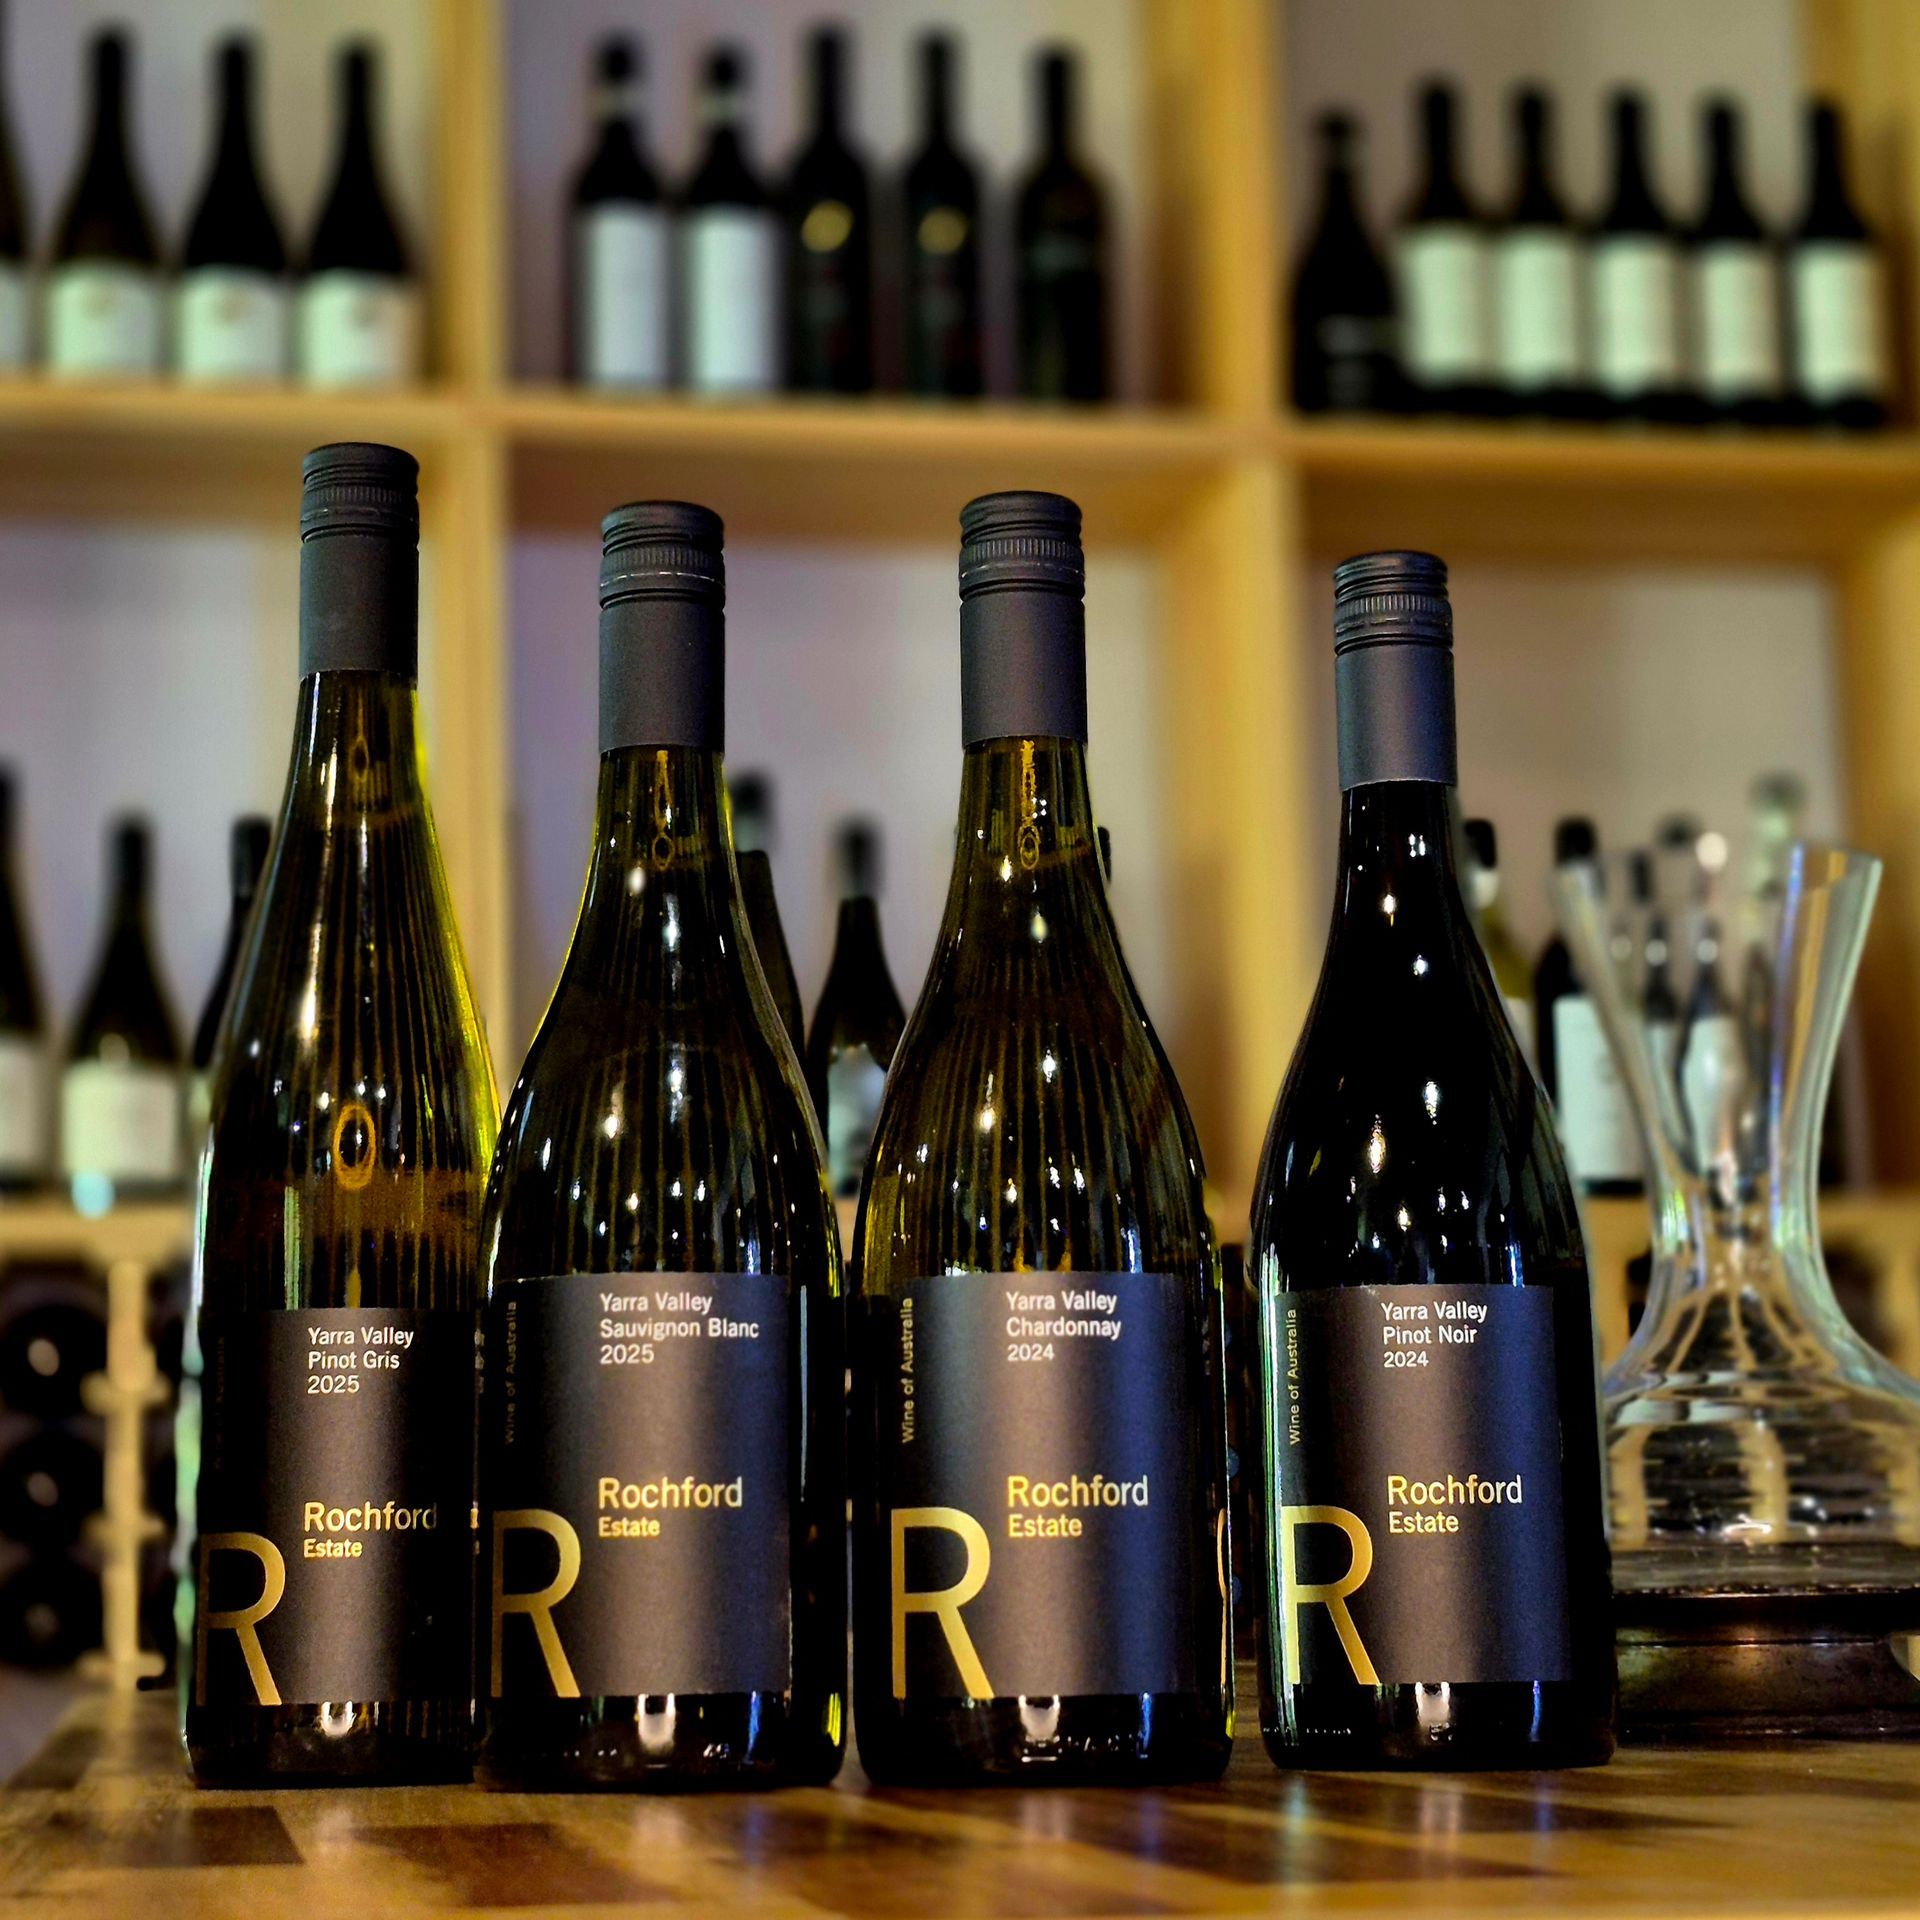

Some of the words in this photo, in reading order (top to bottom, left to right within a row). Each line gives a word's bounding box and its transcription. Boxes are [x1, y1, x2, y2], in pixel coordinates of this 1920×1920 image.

[600, 1292, 649, 1312] Yarra
[655, 1291, 712, 1315] Valley
[1006, 1291, 1055, 1310] Yarra
[1061, 1290, 1117, 1314] Valley
[1381, 1302, 1428, 1320] Yarra
[1433, 1300, 1488, 1323] Valley
[308, 1327, 355, 1345] Yarra
[361, 1326, 414, 1349] Valley
[600, 1317, 701, 1341] Sauvignon
[708, 1317, 759, 1338] Blanc
[901, 1298, 914, 1372] Australia
[1006, 1316, 1121, 1340] Chardonnay
[1383, 1325, 1432, 1345] Pinot
[1438, 1324, 1478, 1344] Noir
[600, 1343, 655, 1364] 2025
[1007, 1343, 1055, 1361] 2024
[1285, 1309, 1298, 1379] Australia
[308, 1351, 357, 1370] Pinot
[363, 1350, 400, 1369] Gris
[1383, 1350, 1429, 1368] 2024
[307, 1374, 360, 1394] 2025
[901, 1378, 914, 1395] of
[1287, 1384, 1299, 1400] of
[902, 1400, 914, 1444] Wine
[1288, 1404, 1300, 1445] Wine
[599, 1476, 743, 1509] Rochford
[1008, 1474, 1149, 1507] Rochford
[1387, 1474, 1523, 1505] Rochford
[304, 1500, 437, 1532] Rochford
[598, 1516, 661, 1537] Estate
[1008, 1513, 1083, 1537] Estate
[1389, 1511, 1459, 1533] Estate
[303, 1537, 363, 1558] Estate
[492, 1509, 580, 1698] R
[891, 1507, 994, 1699] R
[1280, 1505, 1379, 1686] R
[195, 1531, 286, 1706] R
